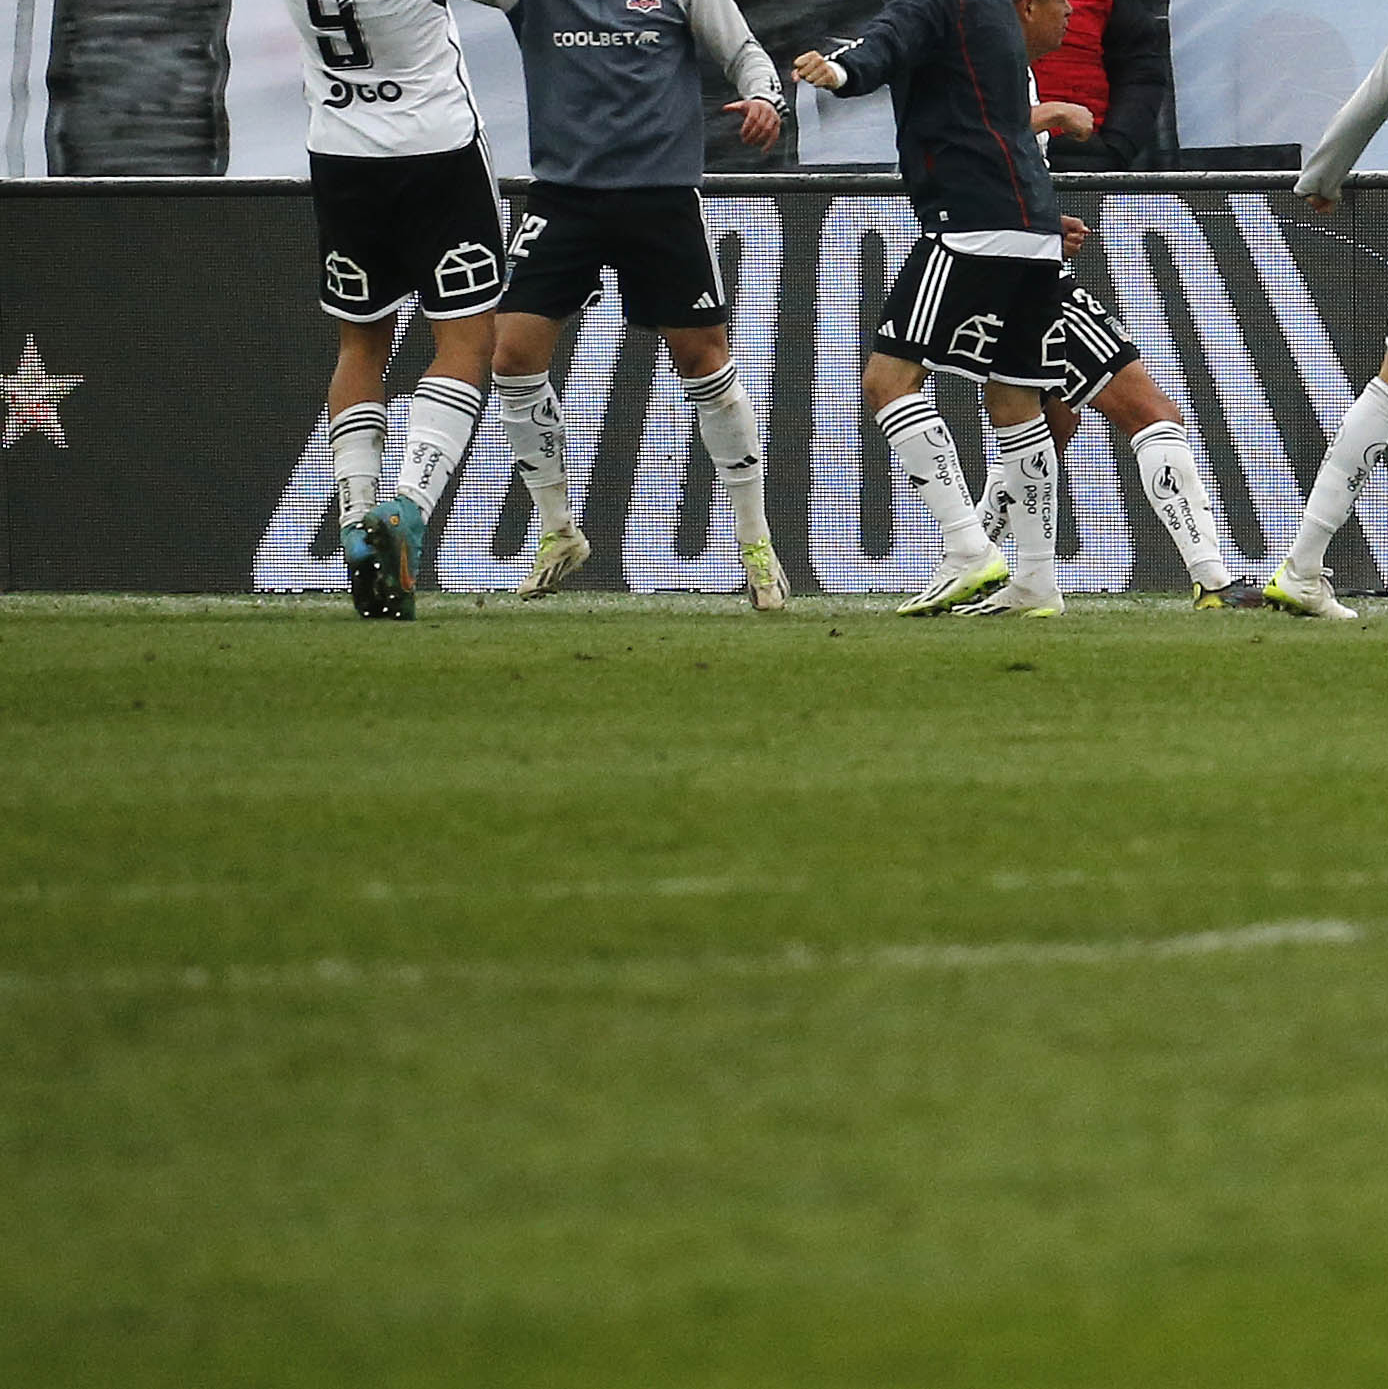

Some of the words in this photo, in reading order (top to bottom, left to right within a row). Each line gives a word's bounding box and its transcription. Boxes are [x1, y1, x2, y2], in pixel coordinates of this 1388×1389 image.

[553, 30, 634, 48] COOLBET
[932, 454, 954, 487] pago
[1024, 484, 1038, 516] pago
[1041, 482, 1055, 540] mercado
[1161, 502, 1183, 533] pago
[1177, 497, 1201, 545] mercado
